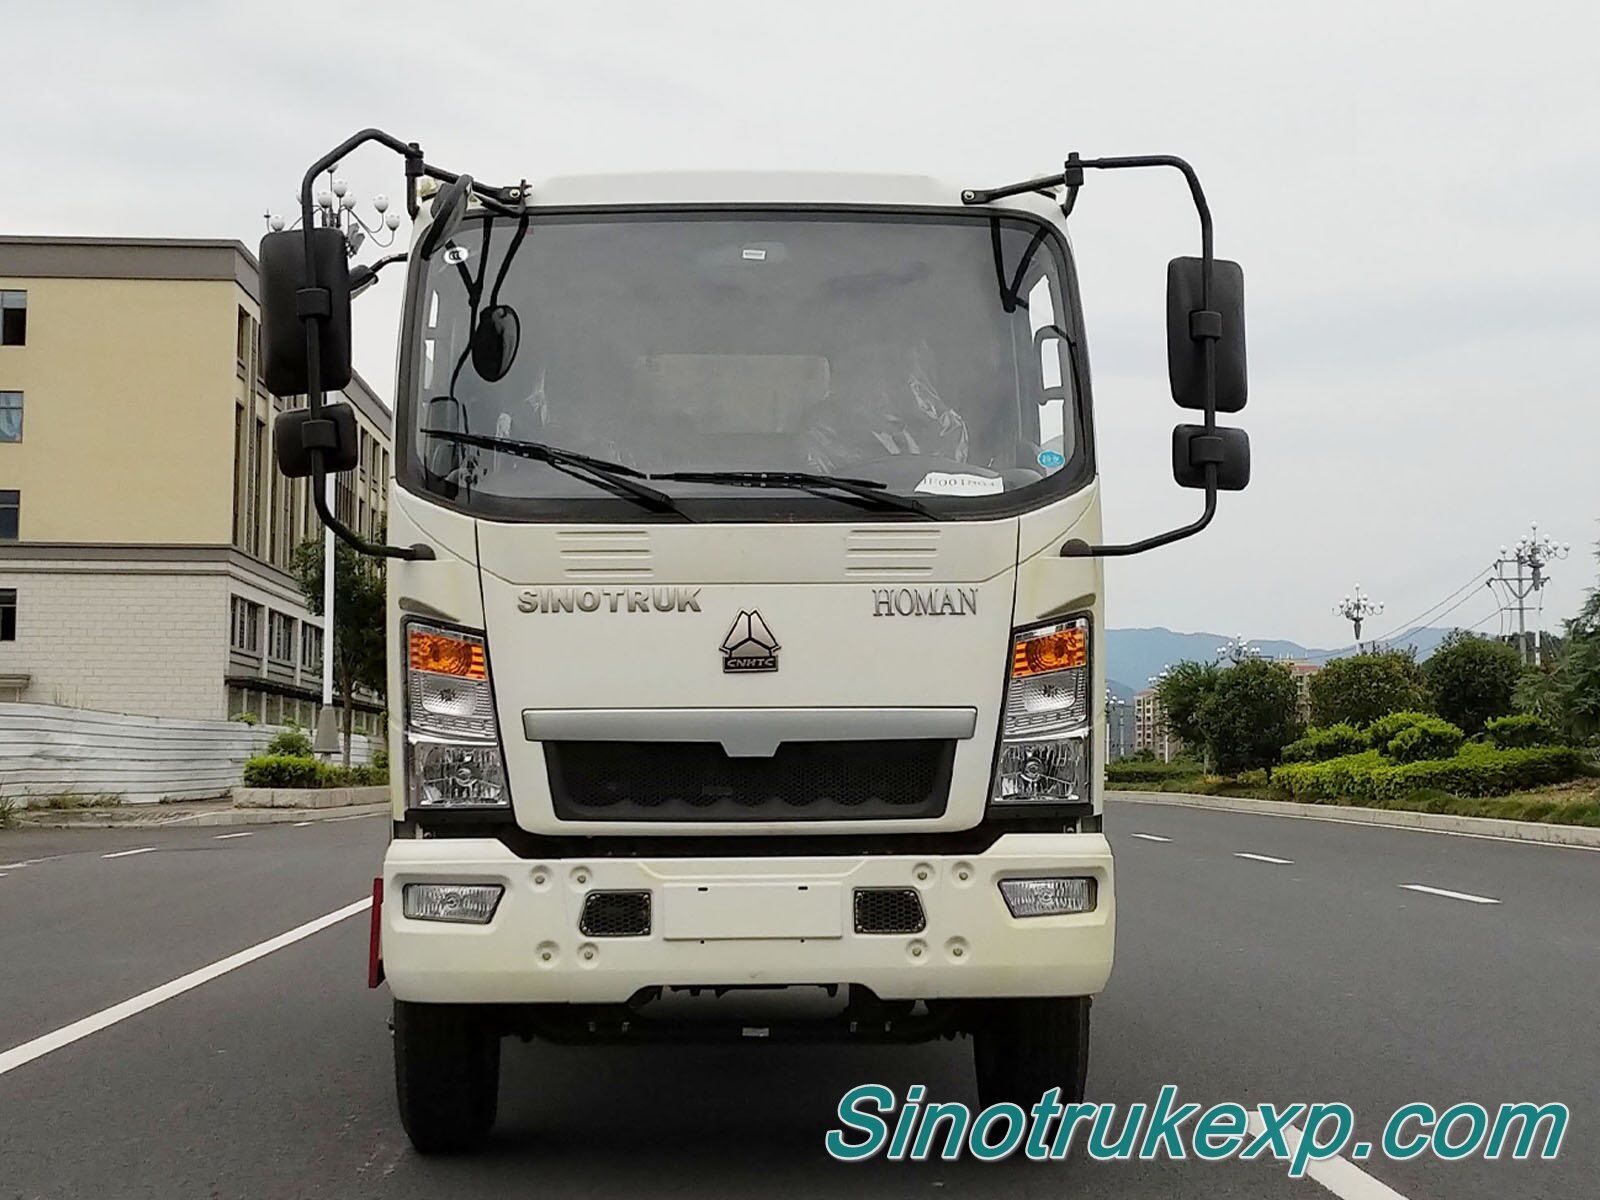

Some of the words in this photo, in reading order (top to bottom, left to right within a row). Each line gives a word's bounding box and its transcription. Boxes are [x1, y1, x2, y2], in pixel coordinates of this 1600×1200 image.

[517, 587, 702, 613] SINOTRUK
[872, 587, 978, 616] HOMAN
[726, 658, 775, 668] CNHTC
